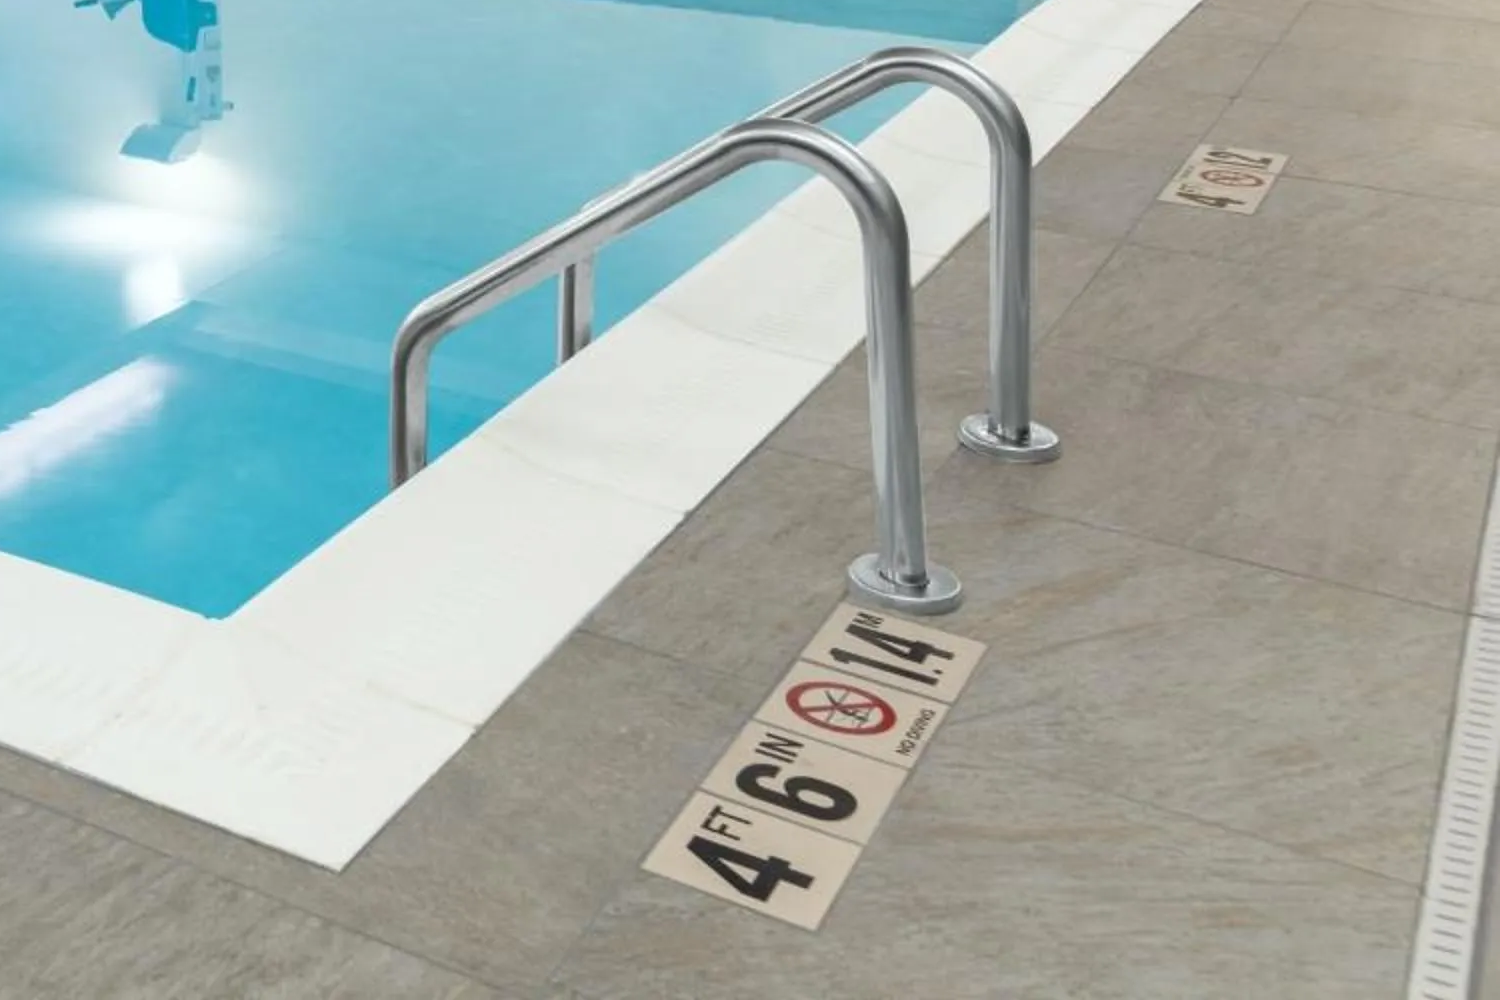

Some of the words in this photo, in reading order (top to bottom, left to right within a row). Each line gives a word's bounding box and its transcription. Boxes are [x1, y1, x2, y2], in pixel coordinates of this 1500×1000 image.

[754, 732, 805, 764] IN
[895, 739, 916, 758] NO
[735, 763, 858, 822] 6
[700, 805, 754, 841] FT
[686, 834, 816, 902] 4
